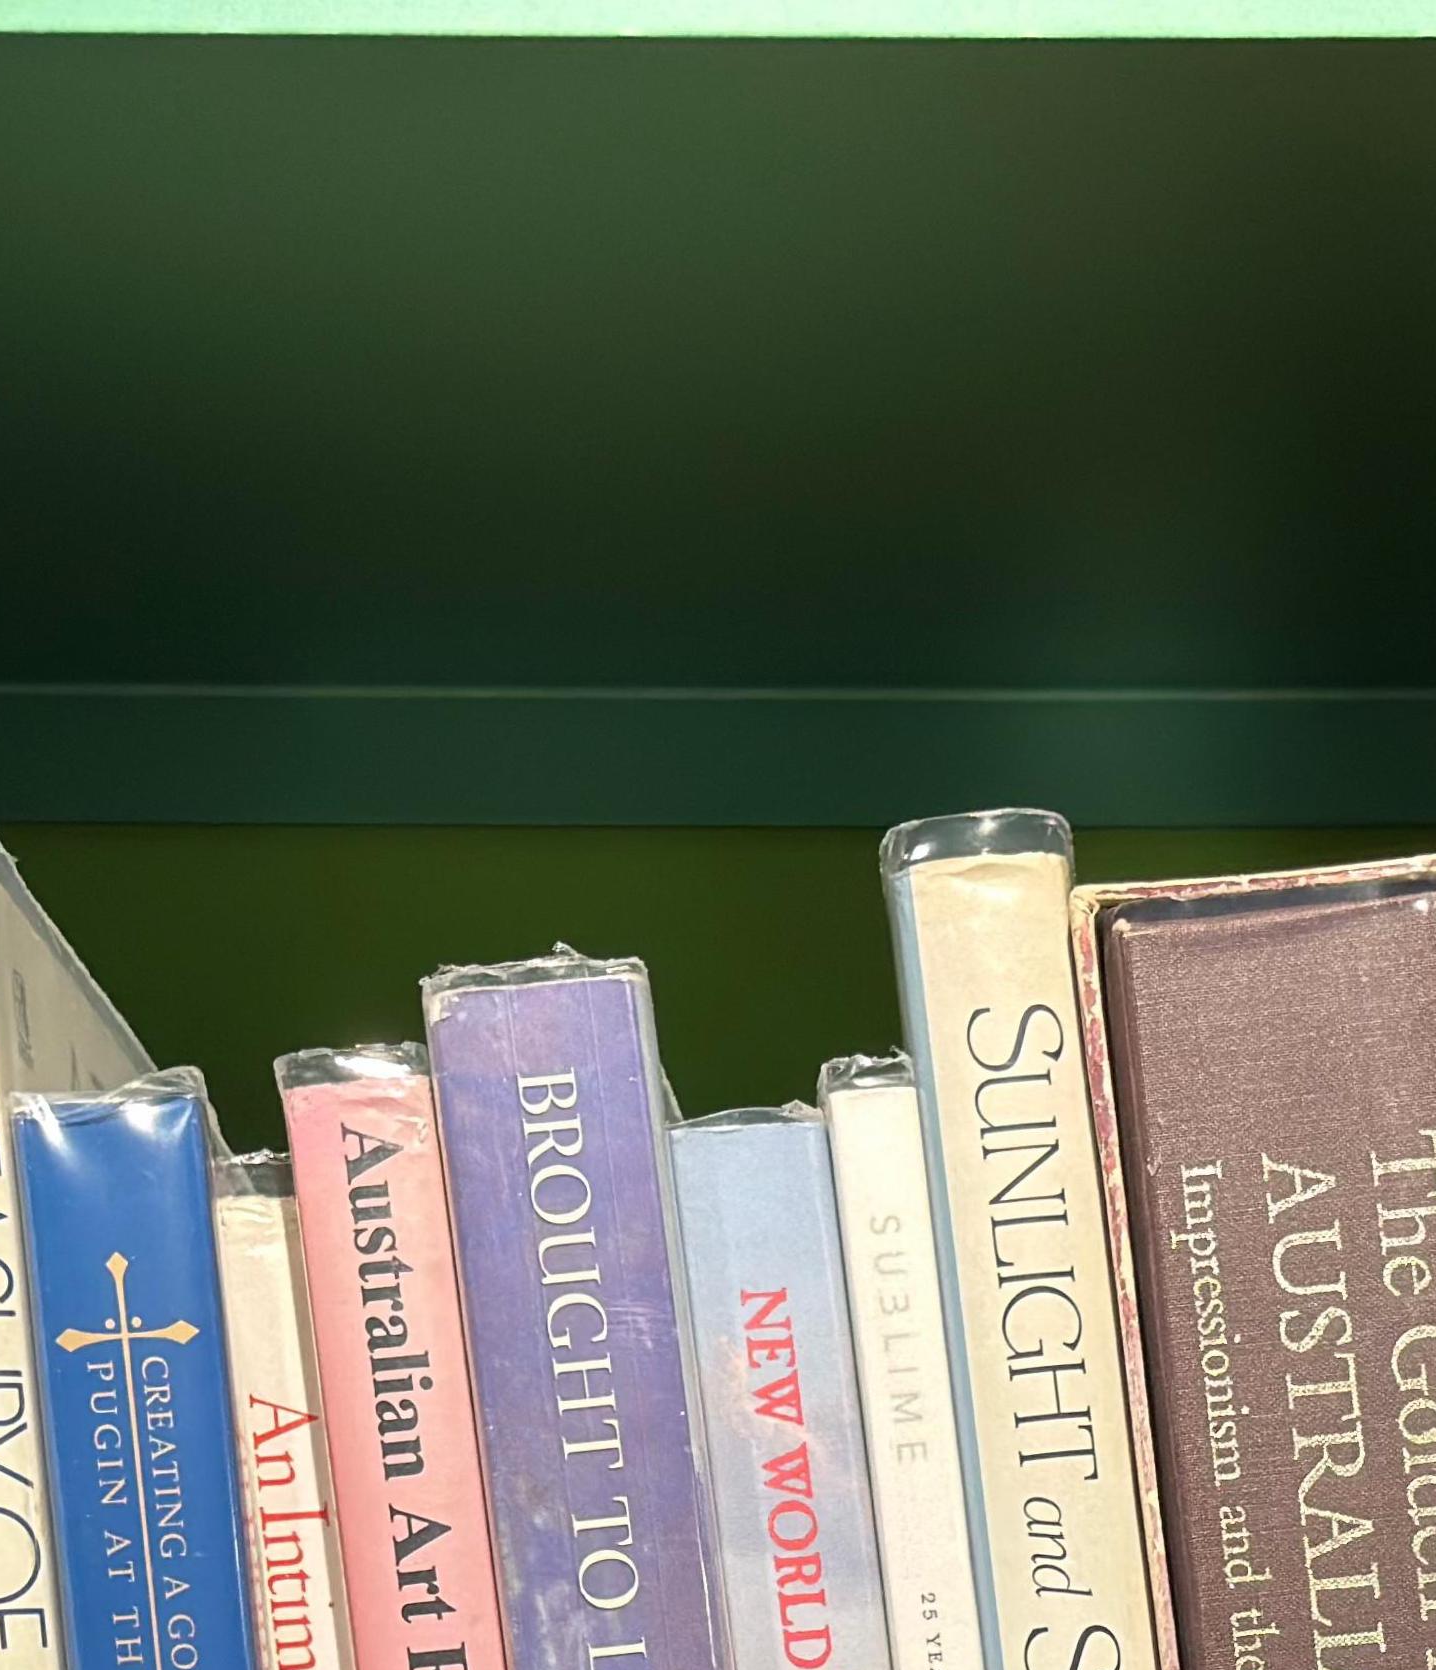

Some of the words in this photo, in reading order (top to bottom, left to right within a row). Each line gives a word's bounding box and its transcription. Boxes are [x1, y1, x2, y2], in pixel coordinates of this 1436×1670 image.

[967, 1003, 1100, 1483] SUNLIGHT
[340, 1125, 439, 1481] Australian
[390, 1503, 454, 1624] Art
[741, 1287, 804, 1425] NEW
[1171, 1162, 1251, 1486] Impressionism
[1218, 1500, 1270, 1589] and
[87, 1361, 127, 1505] PUGIN
[141, 1355, 187, 1559] CREATING
[104, 1531, 135, 1584] AT
[163, 1578, 191, 1600] A
[922, 1593, 938, 1620] 25
[1022, 1495, 1092, 1601] and
